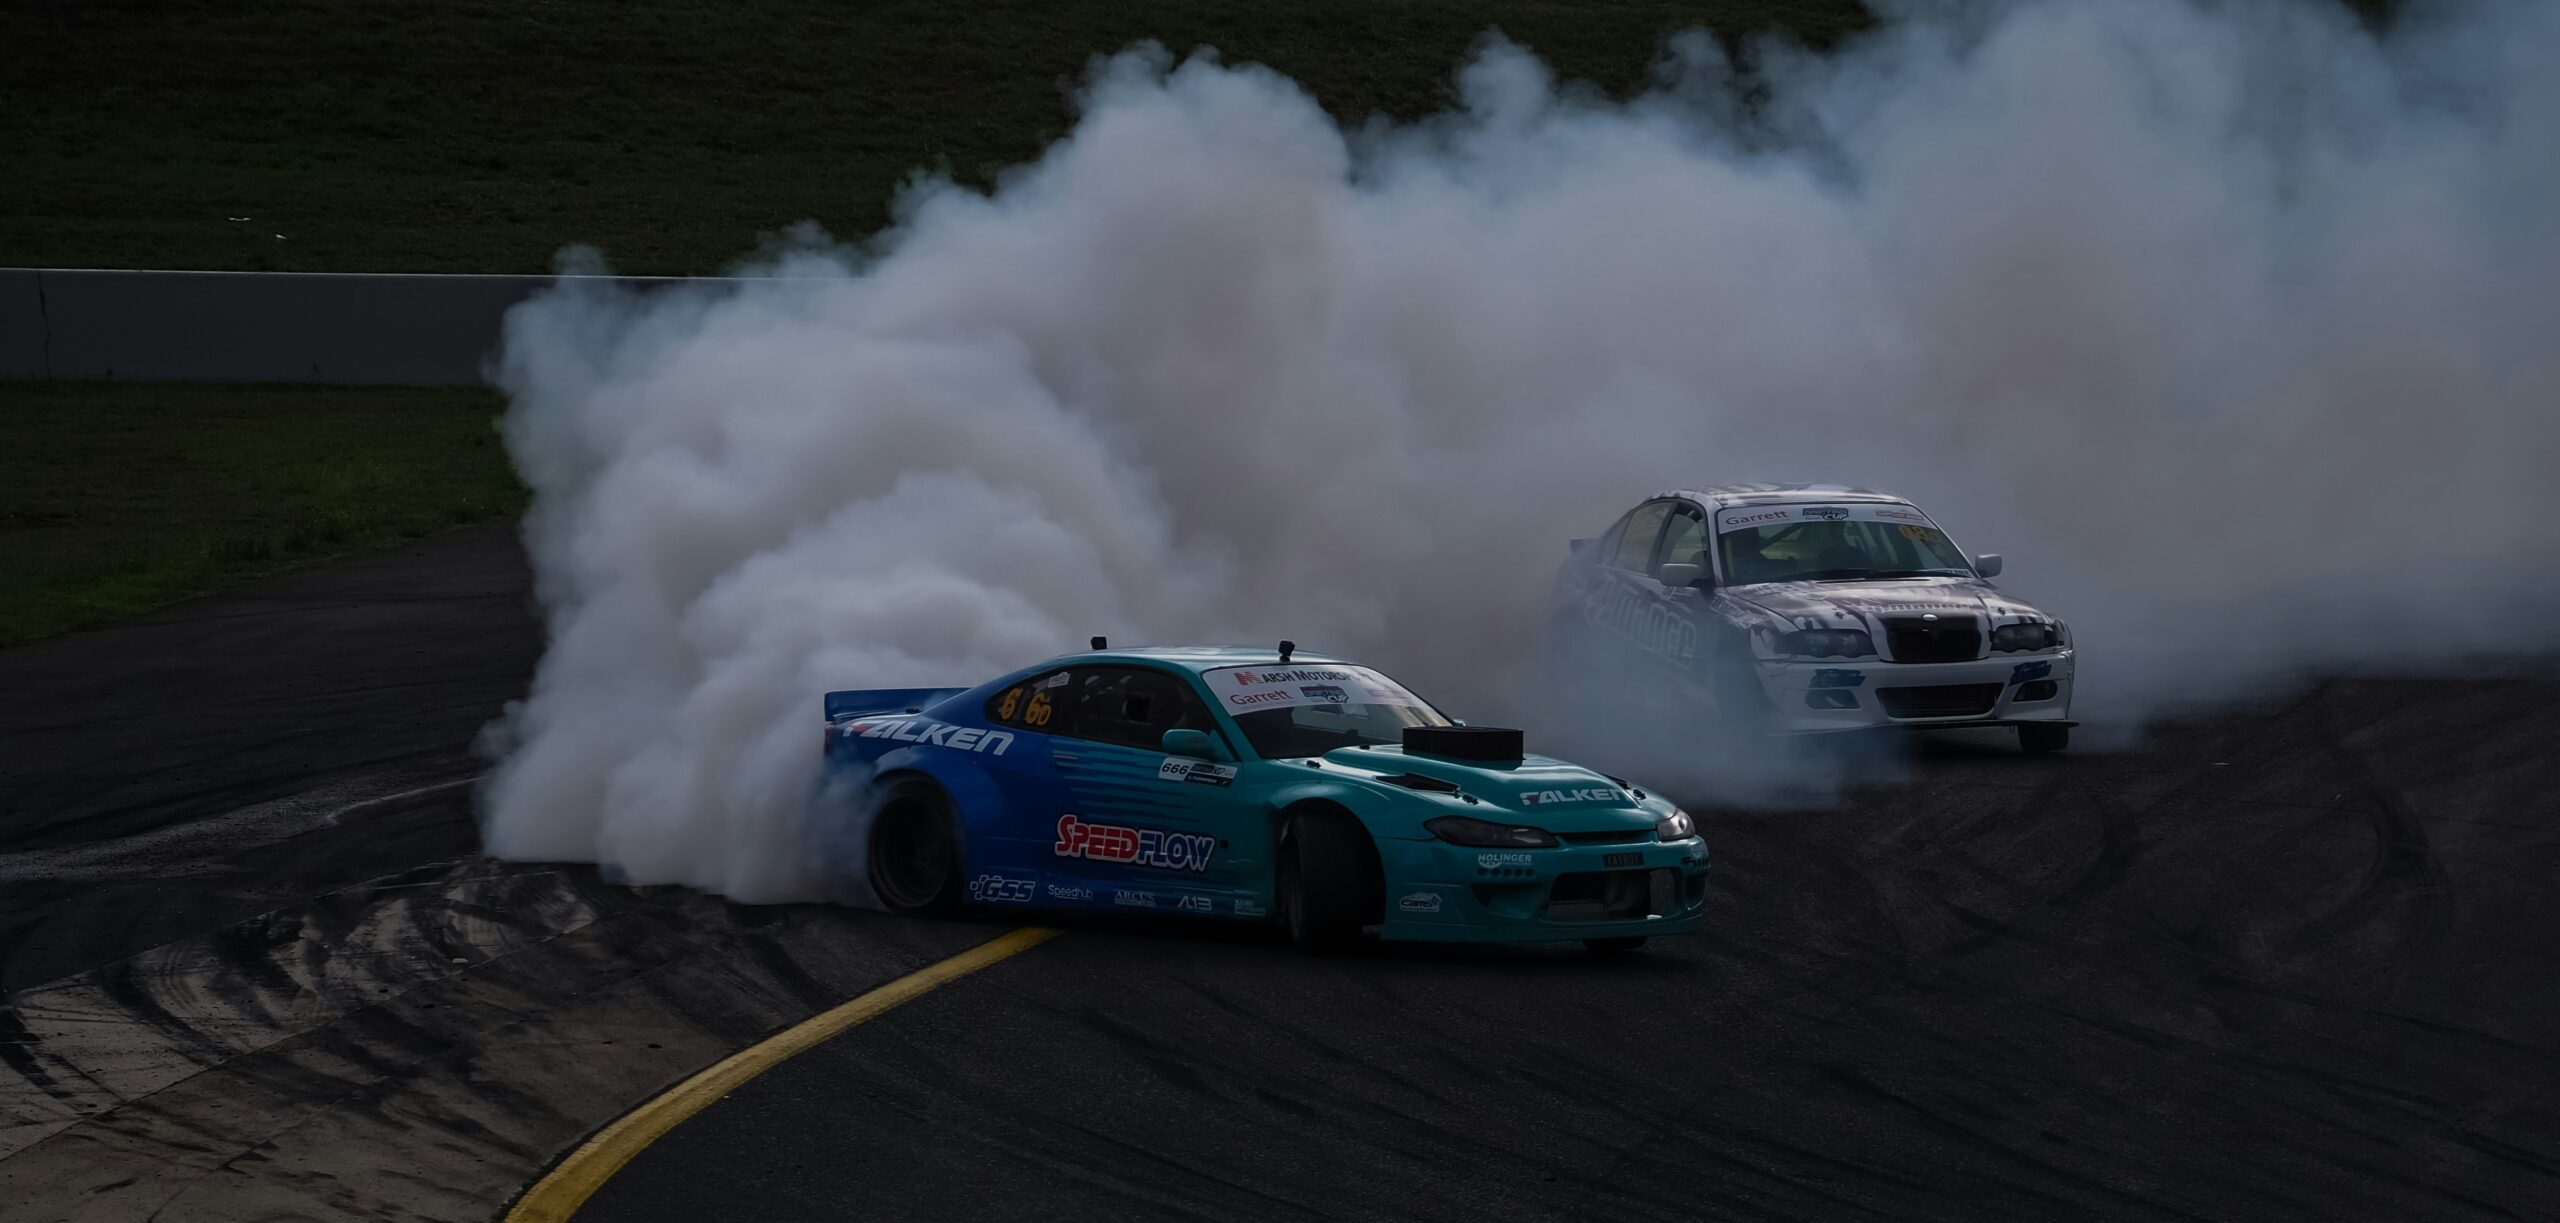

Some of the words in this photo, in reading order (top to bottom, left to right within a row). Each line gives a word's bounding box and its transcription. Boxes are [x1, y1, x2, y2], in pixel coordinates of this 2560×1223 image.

[1726, 510, 1789, 526] Garrett
[1230, 689, 1293, 705] Garrett
[842, 719, 1015, 756] FALKEN
[1161, 763, 1189, 775] 666
[1477, 853, 1532, 863] HOLINGER
[980, 878, 1036, 902] GSS
[1047, 883, 1094, 899] Speedhub
